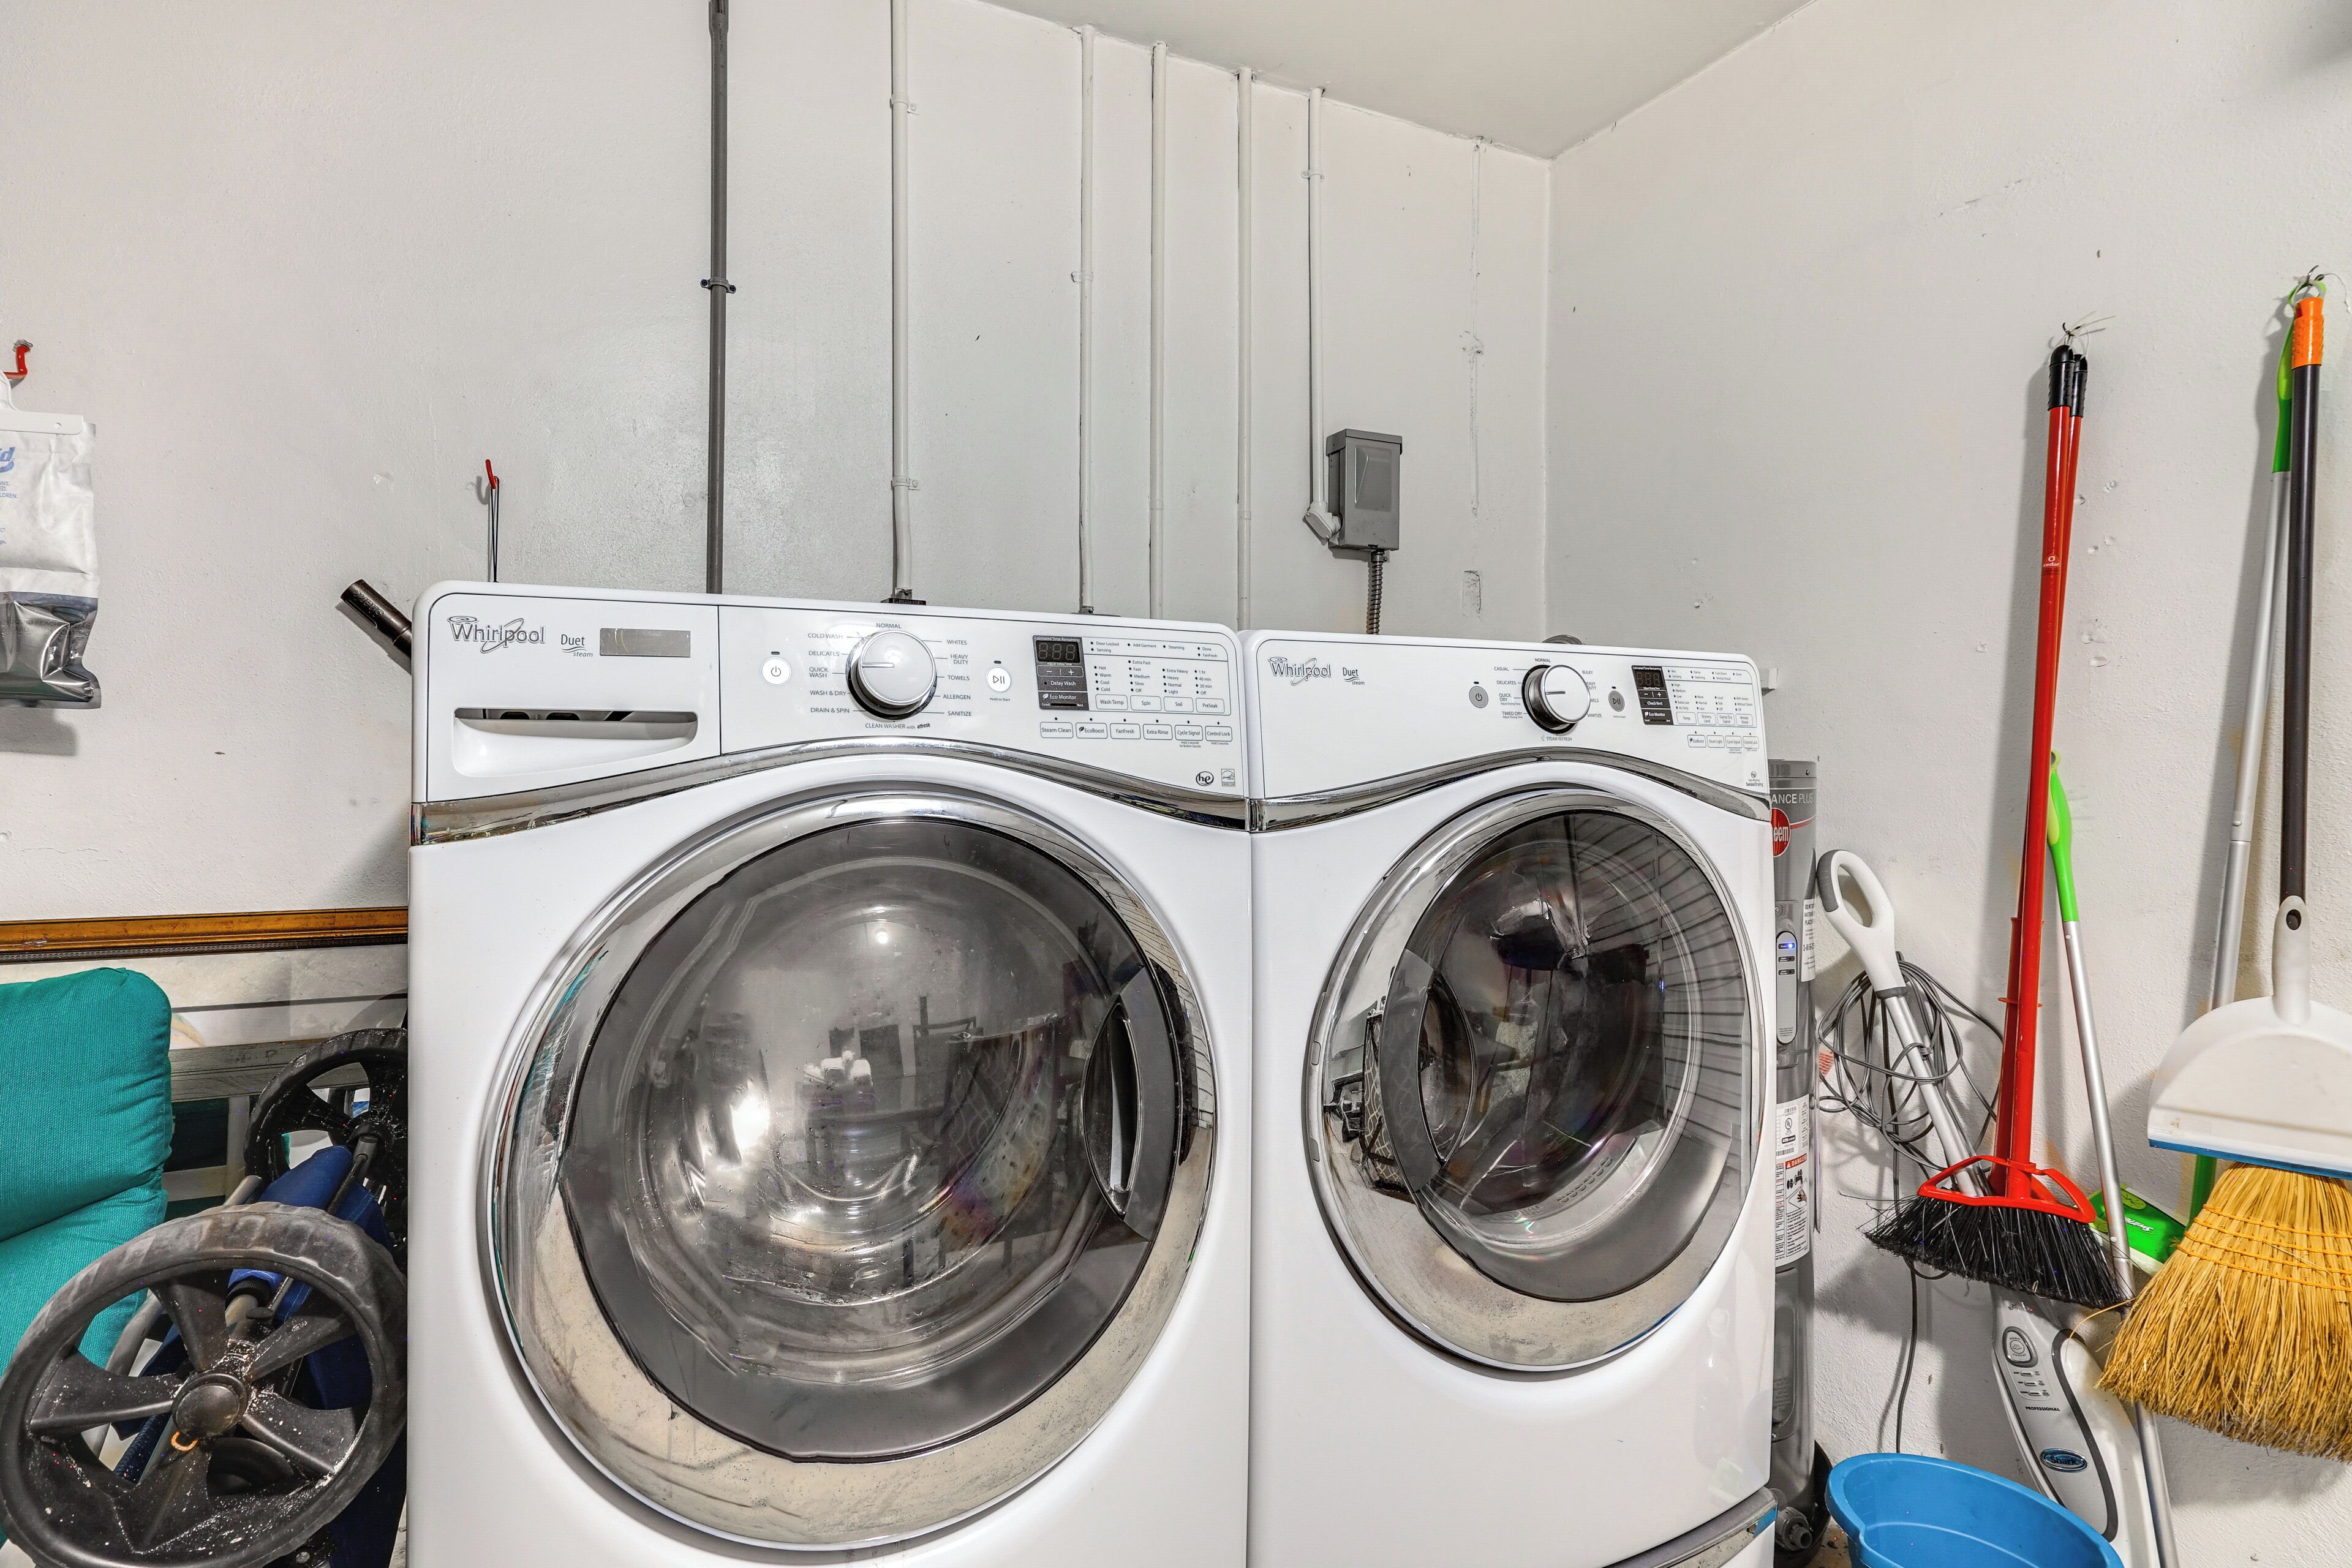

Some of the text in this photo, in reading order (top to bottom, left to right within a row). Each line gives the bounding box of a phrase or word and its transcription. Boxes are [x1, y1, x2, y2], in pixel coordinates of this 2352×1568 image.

[450, 622, 586, 648] Whirlpool Duet
[1270, 662, 1359, 681] Whirlpool Duet
[1799, 793, 1813, 804] PLUS
[2124, 1216, 2155, 1231] Swiffe
[2049, 1456, 2080, 1465] Shark
